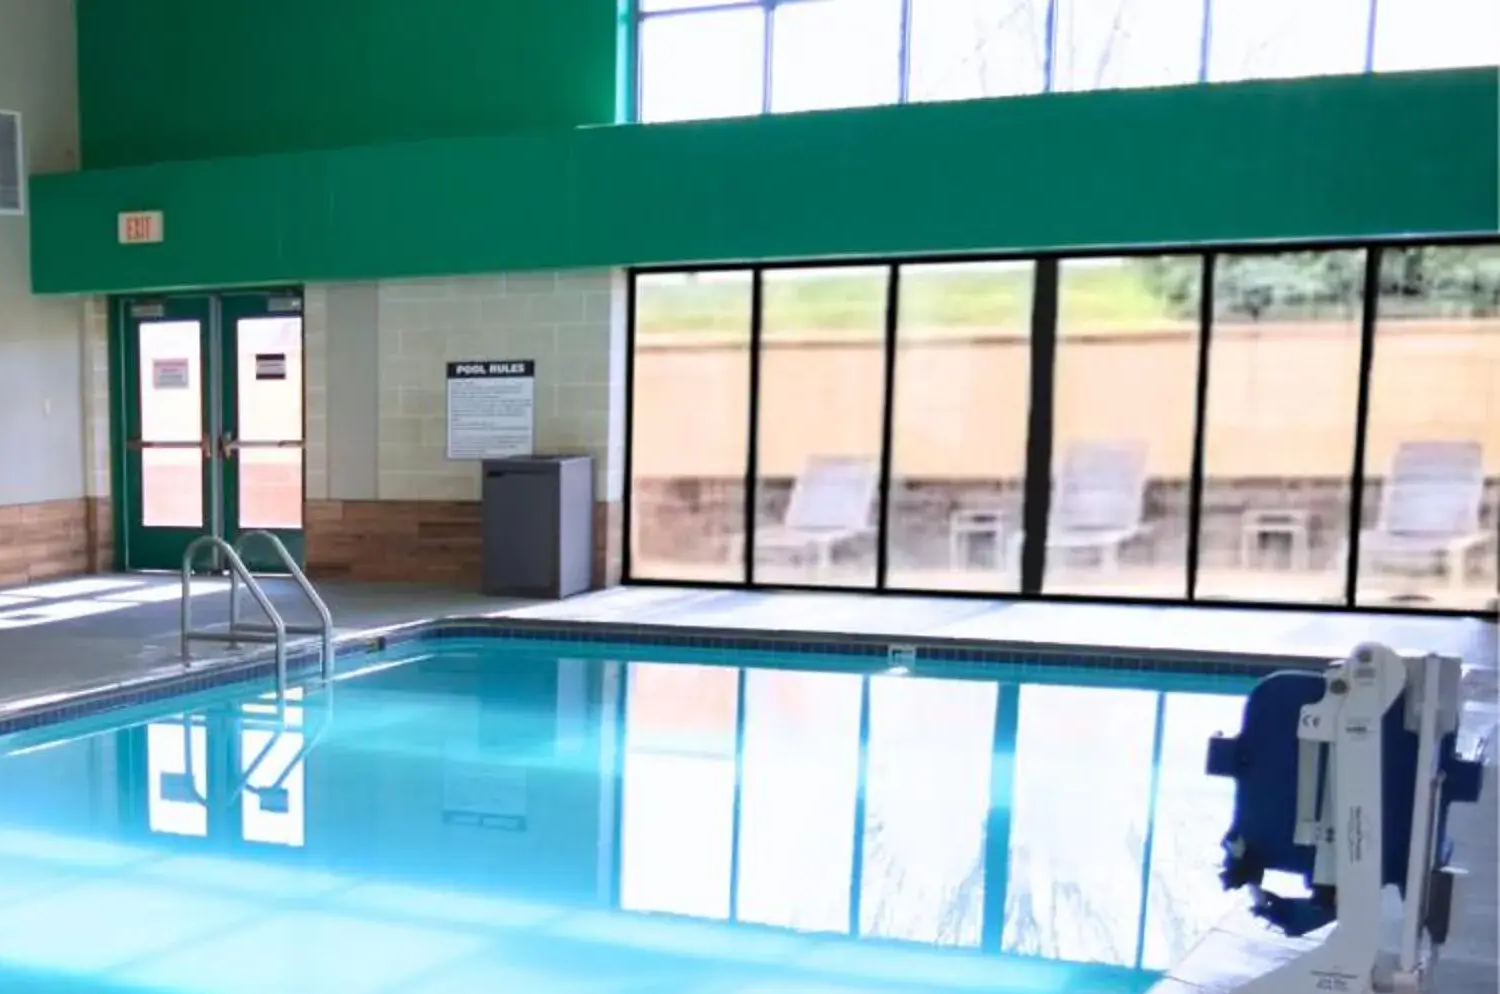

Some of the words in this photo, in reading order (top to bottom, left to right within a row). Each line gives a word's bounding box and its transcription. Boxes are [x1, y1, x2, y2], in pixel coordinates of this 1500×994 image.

[126, 216, 152, 240] EXIT
[456, 364, 486, 375] POOL
[489, 363, 525, 374] RULES
